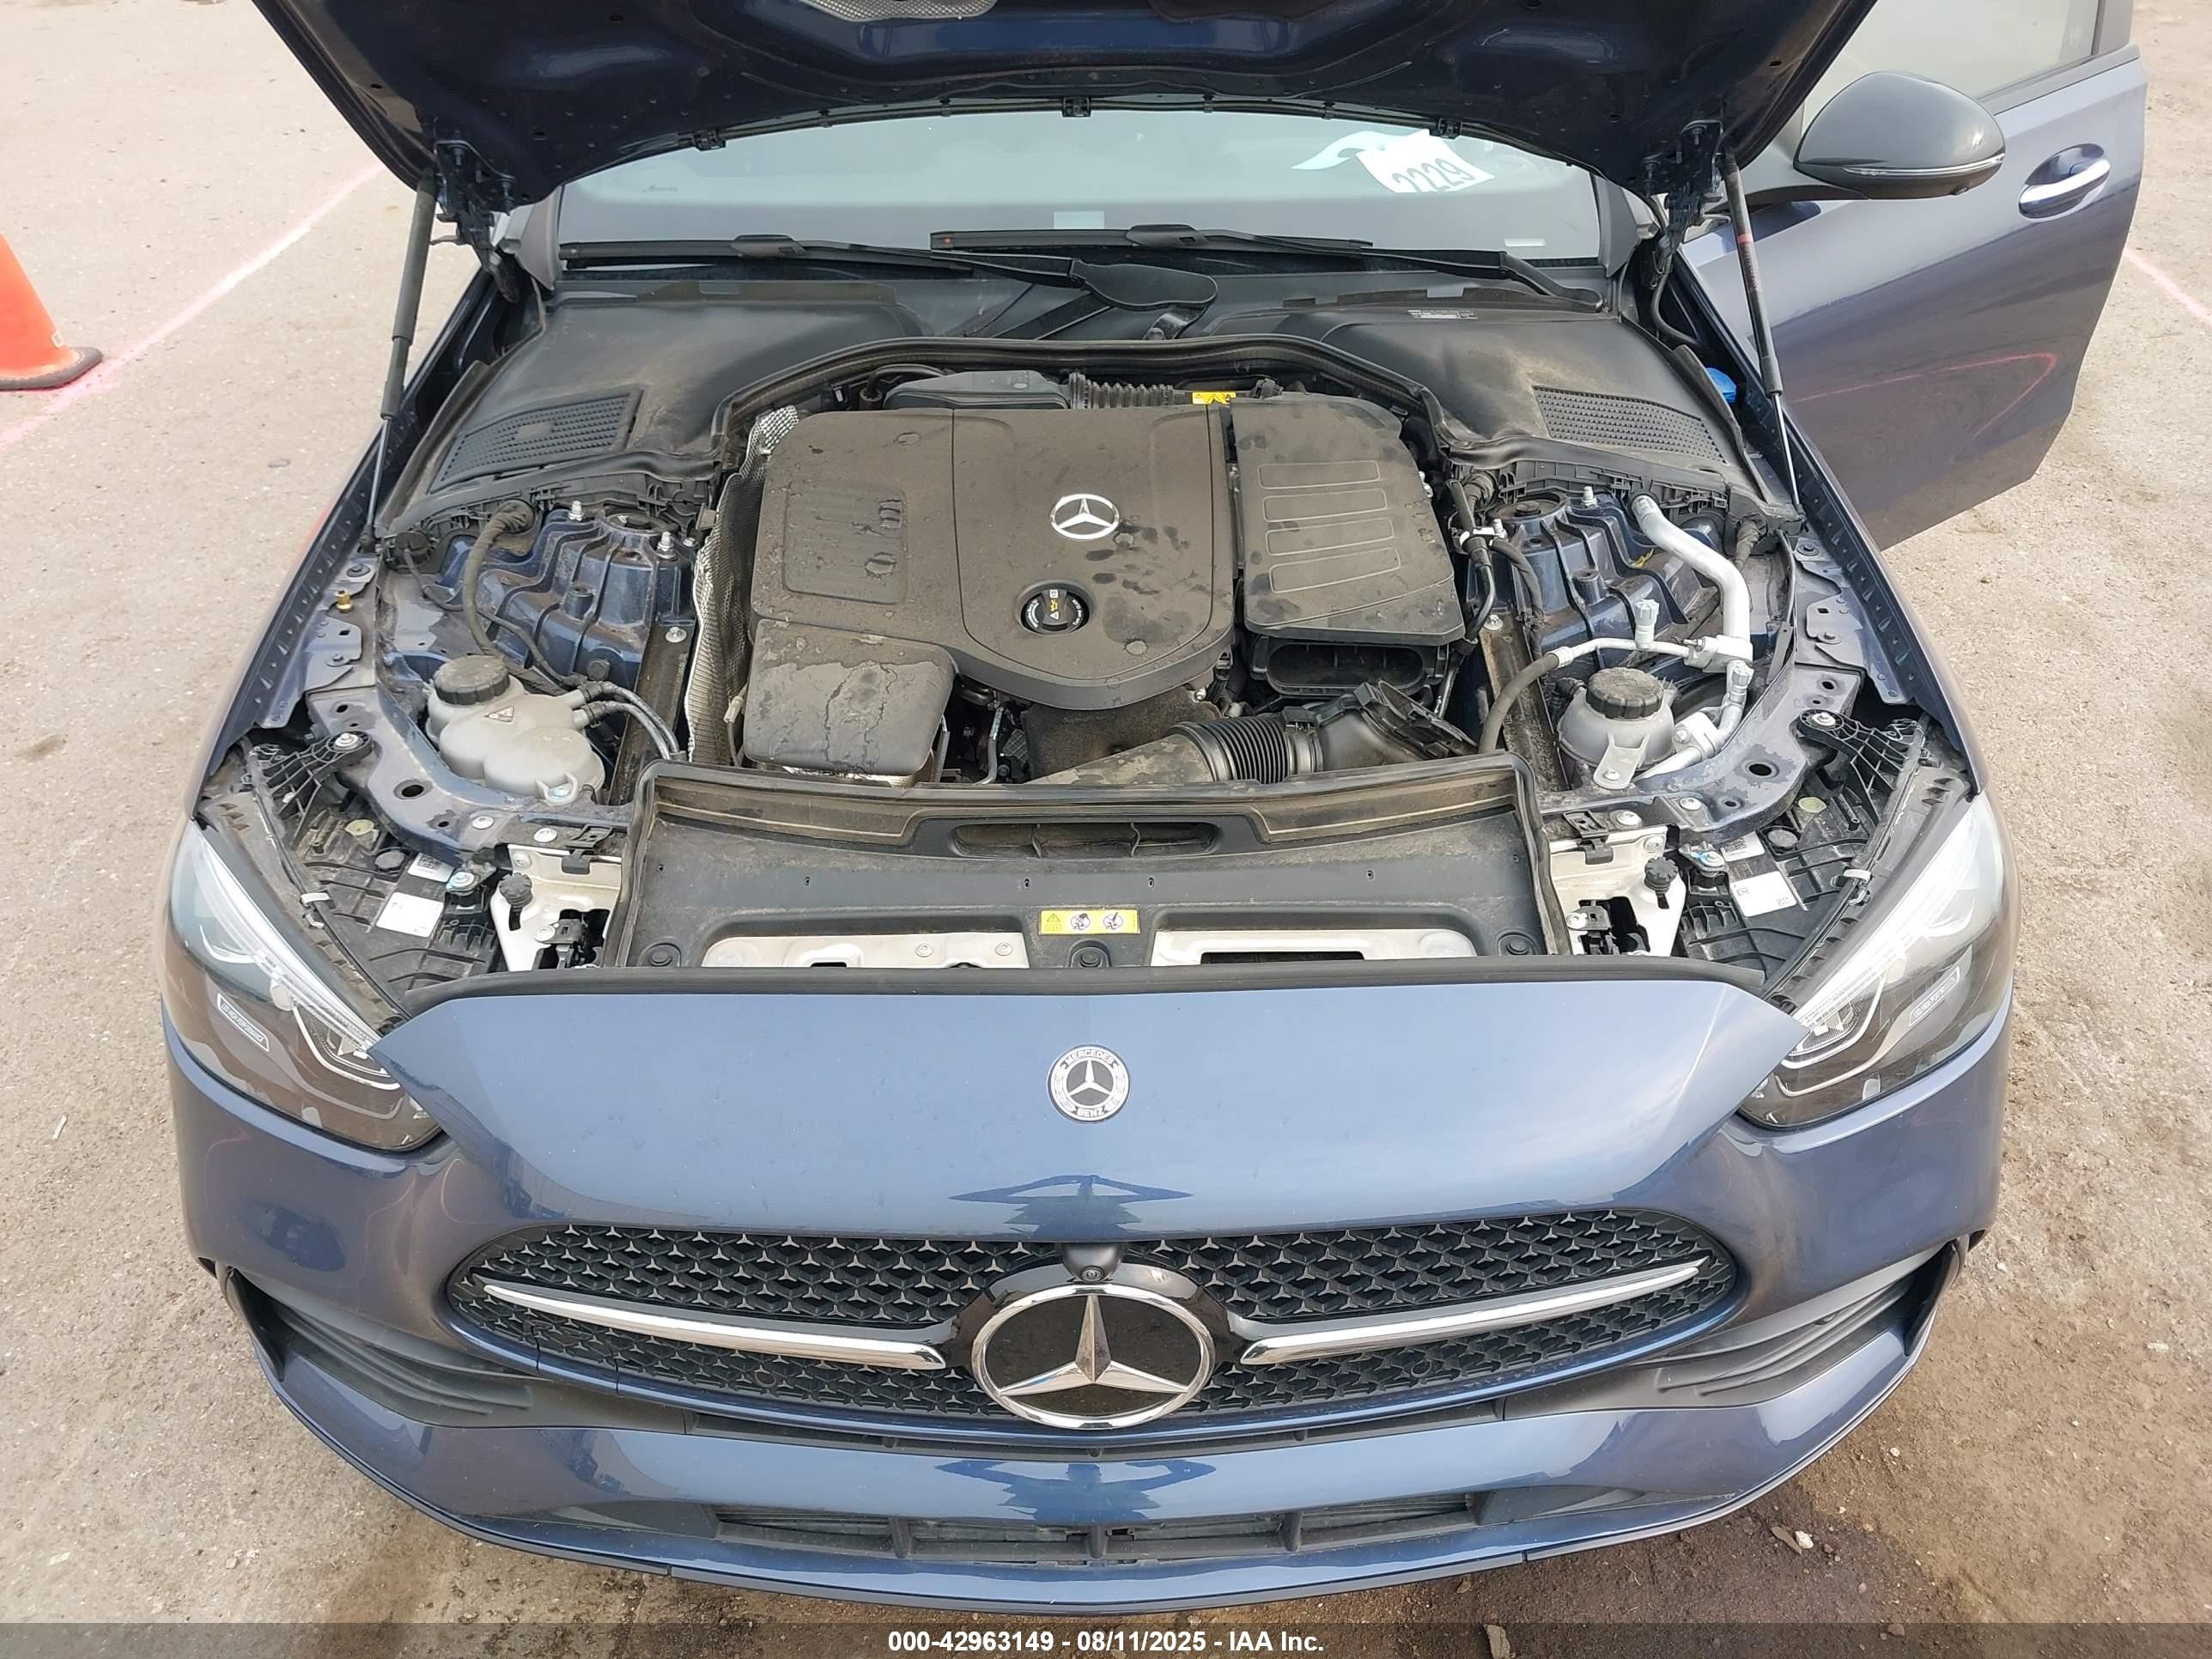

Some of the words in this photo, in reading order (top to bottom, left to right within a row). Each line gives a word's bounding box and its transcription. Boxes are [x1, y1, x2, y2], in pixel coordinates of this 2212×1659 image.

[1392, 158, 1475, 192] 2229
[1064, 1049, 1115, 1066] MERCEDES
[1077, 1108, 1105, 1118] BENZ
